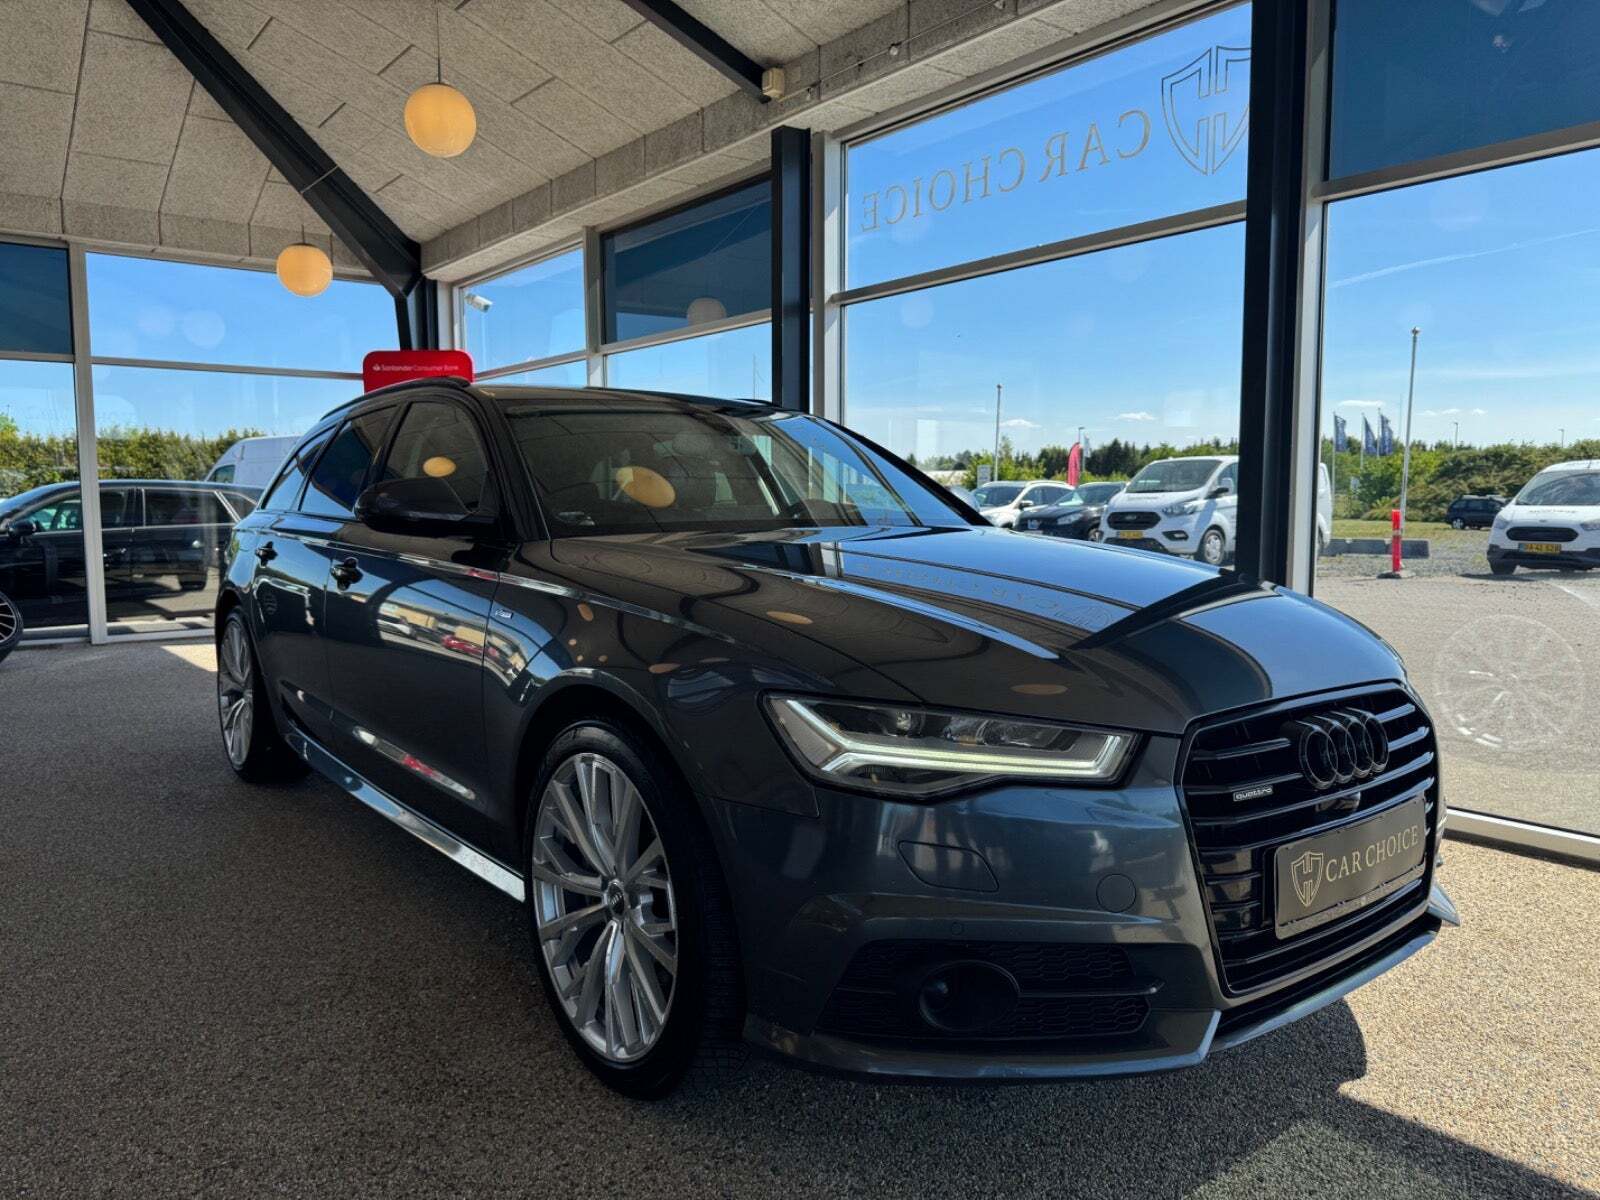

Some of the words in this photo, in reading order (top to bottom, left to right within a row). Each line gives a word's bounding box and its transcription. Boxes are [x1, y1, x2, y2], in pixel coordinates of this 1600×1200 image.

[381, 364, 413, 372] Santander
[1234, 787, 1273, 801] quattro
[1325, 850, 1362, 882] CAR
[1365, 825, 1419, 868] CHOICE
